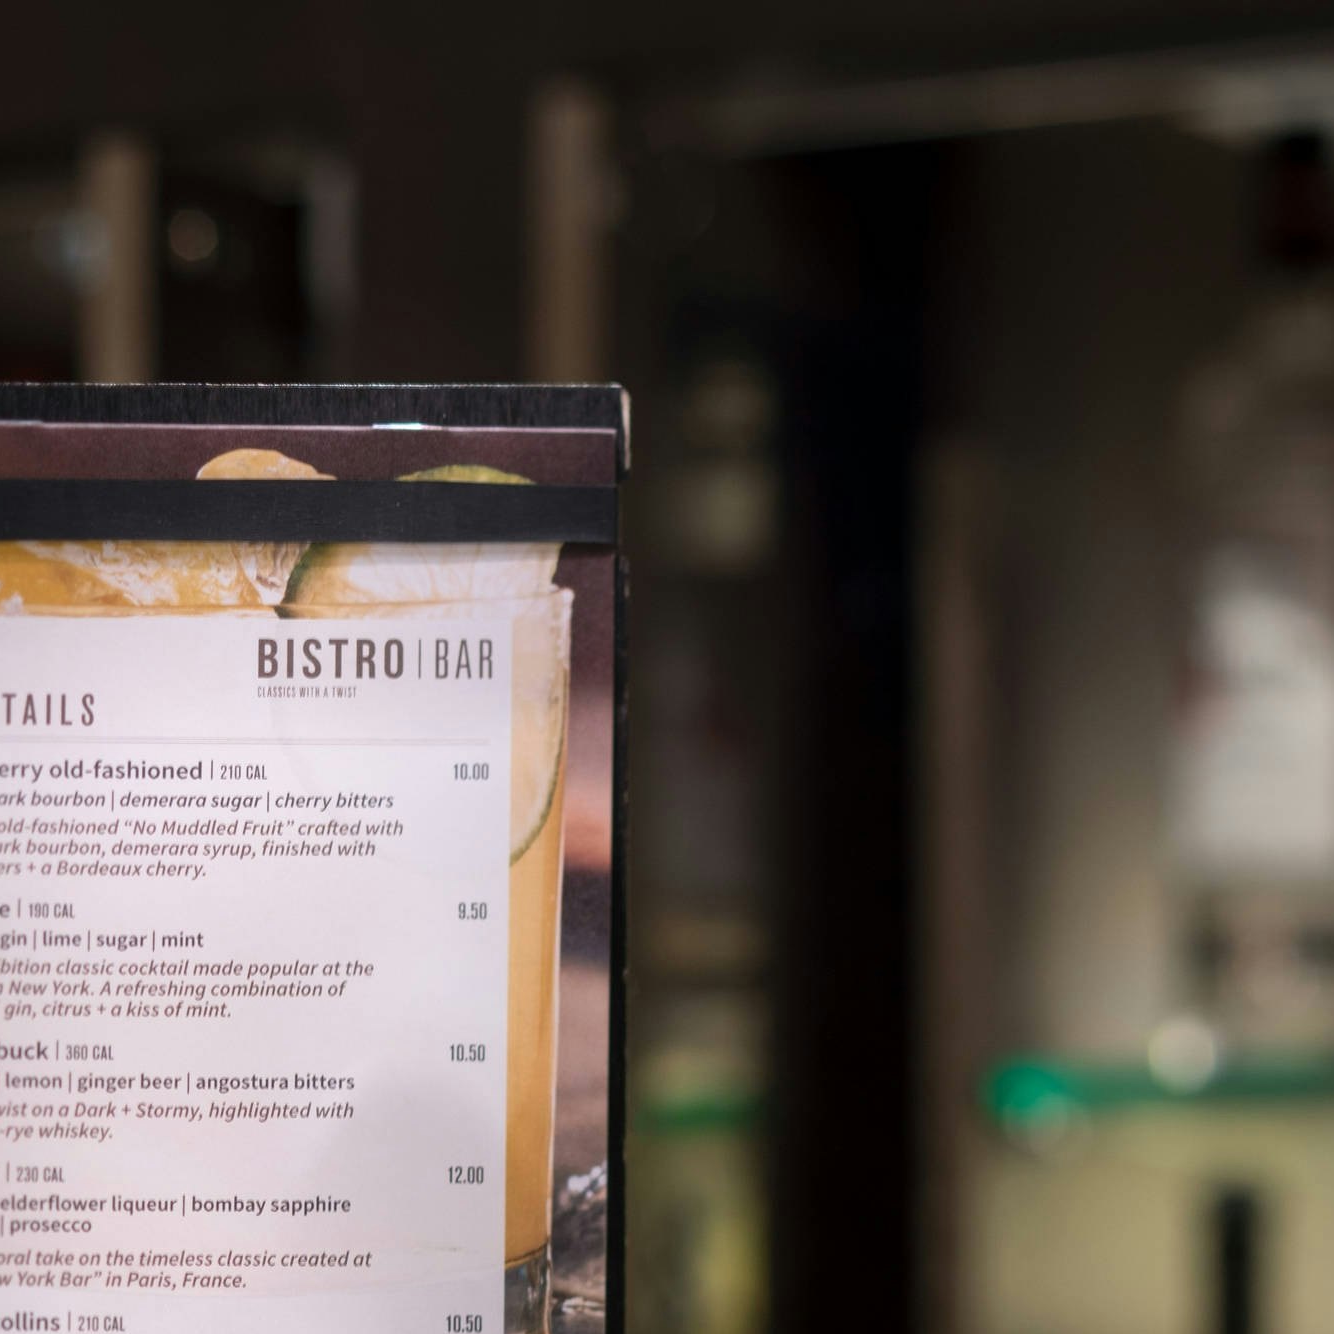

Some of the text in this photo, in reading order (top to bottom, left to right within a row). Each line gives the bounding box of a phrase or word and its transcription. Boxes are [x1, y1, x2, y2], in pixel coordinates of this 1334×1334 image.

[257, 638, 494, 679] BISTRO BAR
[256, 684, 358, 698] CLASSICS WITH A TWIST
[48, 760, 204, 780] old-fashioned
[219, 765, 243, 780] 210
[244, 765, 268, 780] CAL
[453, 763, 491, 780] 10.00
[29, 791, 107, 807] bourbon
[118, 792, 209, 807] demerara
[209, 796, 264, 812] sugar
[273, 793, 334, 812] cherry
[334, 793, 395, 808] bitters
[160, 819, 240, 835] Muddled
[296, 820, 364, 836] crafted
[364, 820, 404, 836] with
[24, 839, 377, 860] bourbon, demerara syrup, finished with
[39, 860, 207, 880] a Bordeaux cherry.
[52, 903, 77, 918] CAL
[457, 902, 489, 920] 9.50
[41, 931, 83, 947] lime
[95, 935, 148, 951] sugar
[160, 932, 205, 947] mint
[55, 959, 375, 981] classic cocktail made popular at the
[7, 980, 347, 1001] New York. A refreshing combination of
[2, 1000, 232, 1020] gin, citrus a kiss of mint.
[91, 1045, 115, 1060] CAL
[449, 1044, 487, 1062] 10.50
[3, 1072, 355, 1094] lemon ginger beer angostura bitters
[30, 1102, 355, 1123] on a Dark Stormy, highlighted with
[37, 1122, 113, 1142] whiskey.
[41, 1167, 67, 1182] CAL
[448, 1166, 485, 1184] 12.00
[110, 1195, 178, 1215] liqueur
[190, 1196, 267, 1216] bombay
[270, 1196, 352, 1216] sapphire
[8, 1220, 93, 1235] prosecco
[34, 1250, 373, 1267] take on the timeless classic created at
[16, 1271, 57, 1287] York
[104, 1272, 124, 1287] in
[125, 1272, 178, 1290] Paris,
[181, 1272, 247, 1288] France.
[76, 1315, 101, 1332] 210
[102, 1316, 127, 1332] CAL
[446, 1315, 484, 1333] 10.50
